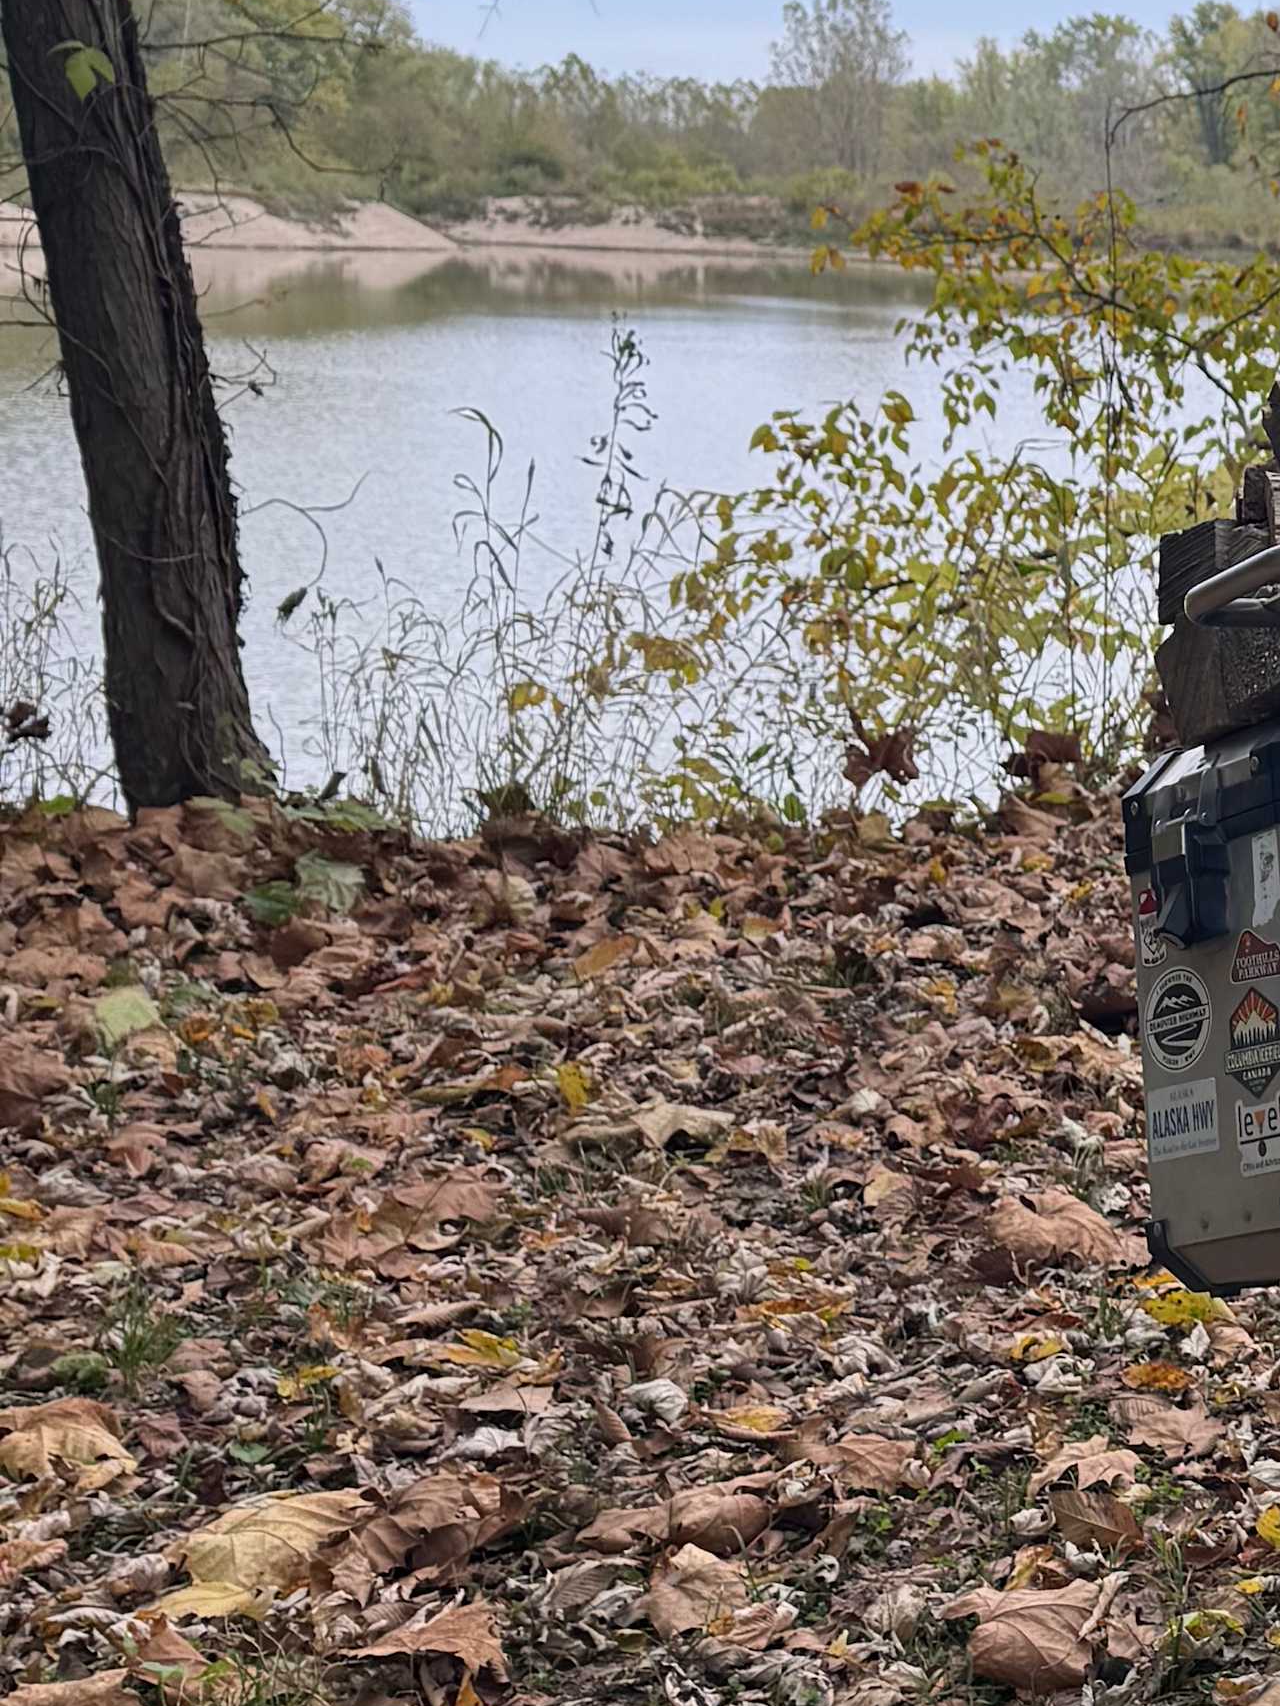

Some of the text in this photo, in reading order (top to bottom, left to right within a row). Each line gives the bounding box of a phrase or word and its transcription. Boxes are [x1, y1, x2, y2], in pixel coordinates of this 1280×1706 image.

[1236, 949, 1280, 970] FOOTHILLS
[1239, 962, 1278, 980] PARKWAY
[1152, 1099, 1215, 1140] ALASKA HWY
